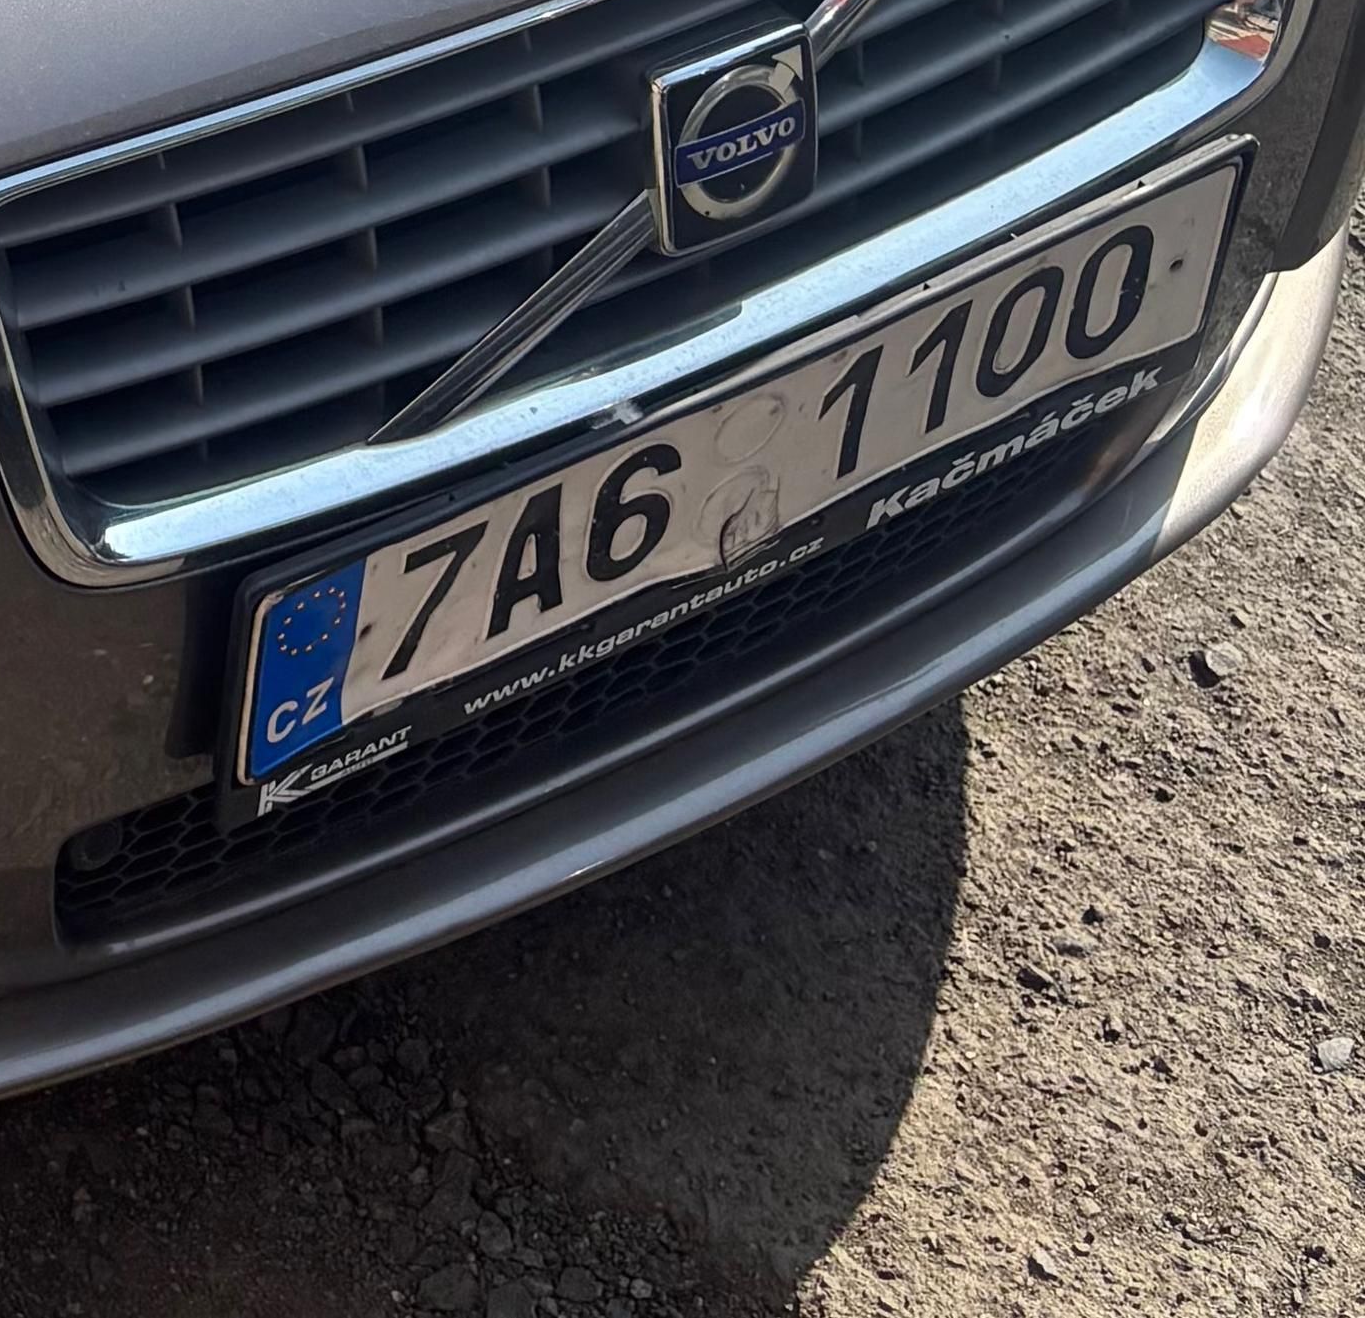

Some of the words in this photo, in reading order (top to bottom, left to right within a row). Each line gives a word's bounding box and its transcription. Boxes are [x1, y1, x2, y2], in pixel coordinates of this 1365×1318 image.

[687, 117, 796, 170] VOLVO
[381, 443, 682, 681] 7A6
[819, 225, 1155, 479] 1100
[866, 366, 1163, 530] Kačmáček
[464, 537, 824, 715] www.kkgarantauto.cz
[267, 677, 334, 743] CZ
[310, 725, 412, 781] GARANT
